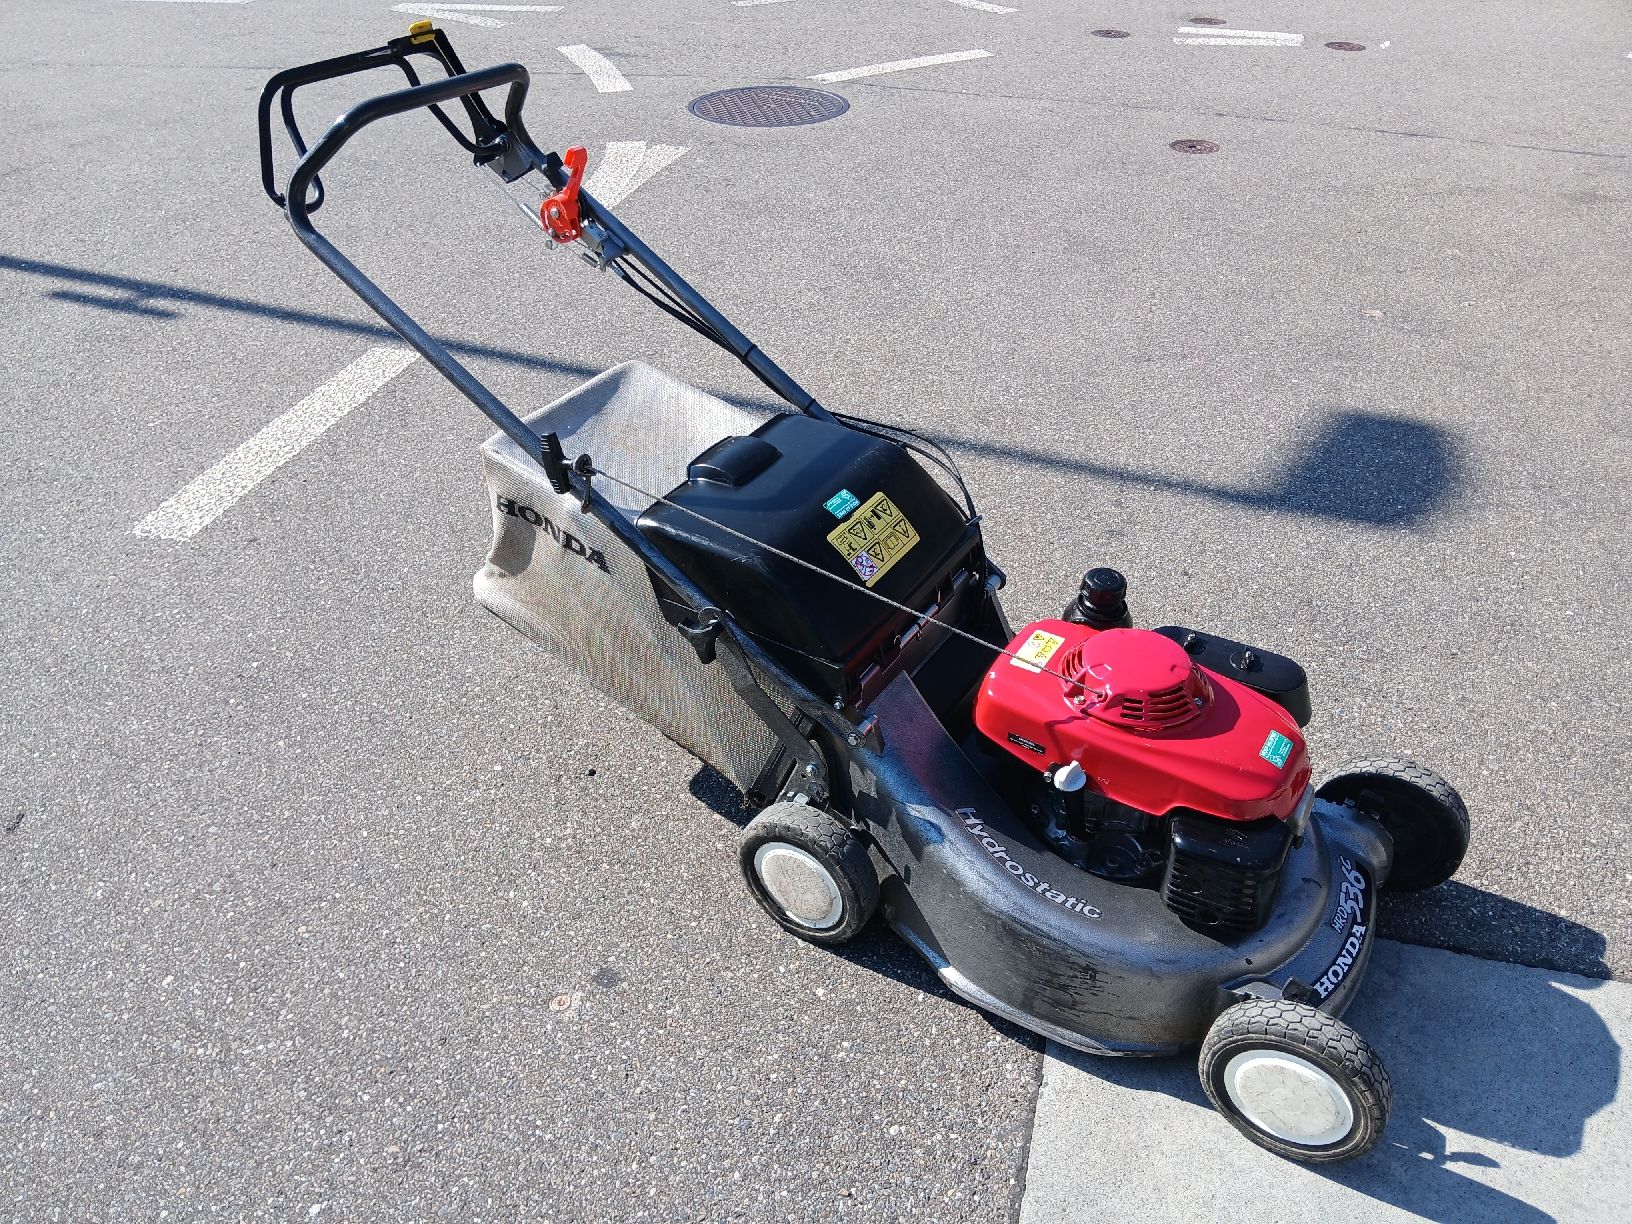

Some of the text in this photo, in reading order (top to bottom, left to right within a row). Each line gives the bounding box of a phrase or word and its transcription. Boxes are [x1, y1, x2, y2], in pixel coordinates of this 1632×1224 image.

[497, 494, 612, 575] HONDA
[955, 807, 1103, 919] Hydrostatic
[1313, 924, 1367, 999] HONDA
